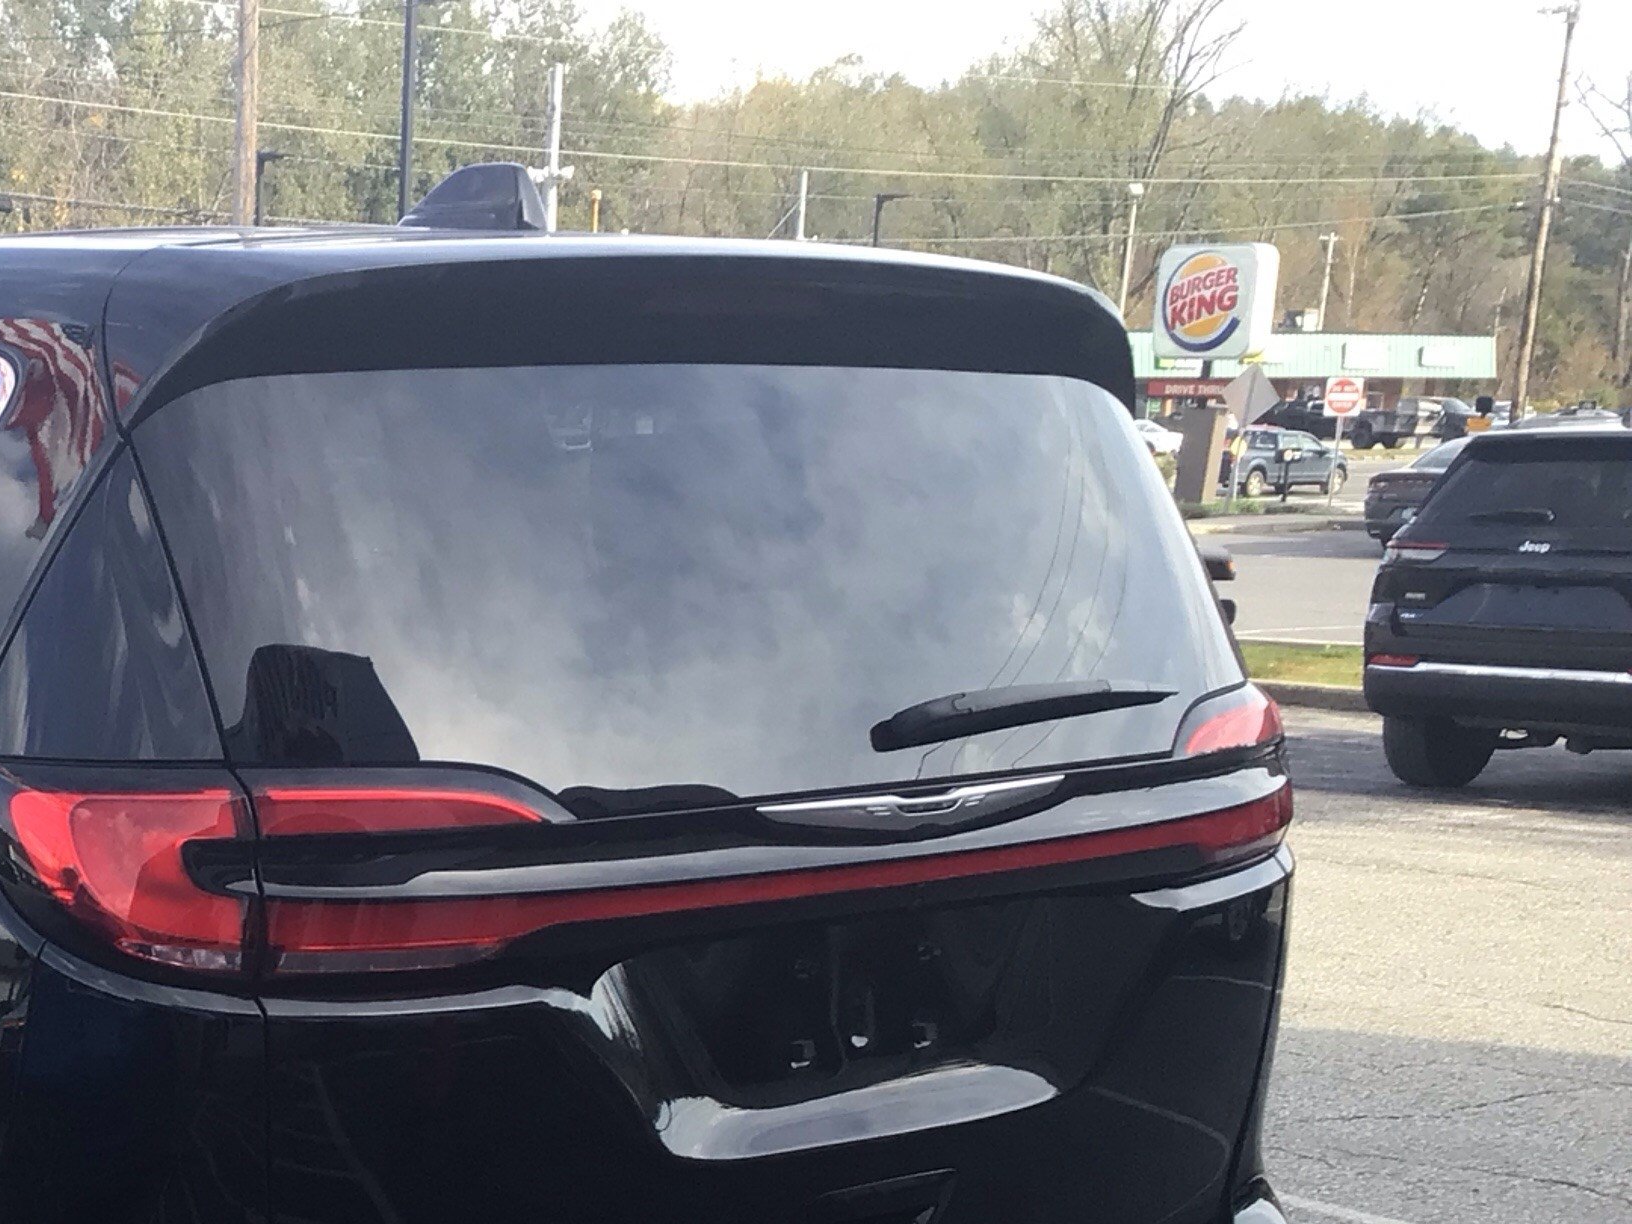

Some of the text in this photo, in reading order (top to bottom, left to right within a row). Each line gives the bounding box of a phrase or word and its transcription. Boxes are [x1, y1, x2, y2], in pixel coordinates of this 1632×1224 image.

[1169, 267, 1238, 305] BURGER
[1170, 286, 1239, 330] KING
[1164, 384, 1196, 395] DRIVE
[1518, 540, 1550, 554] Jeep
